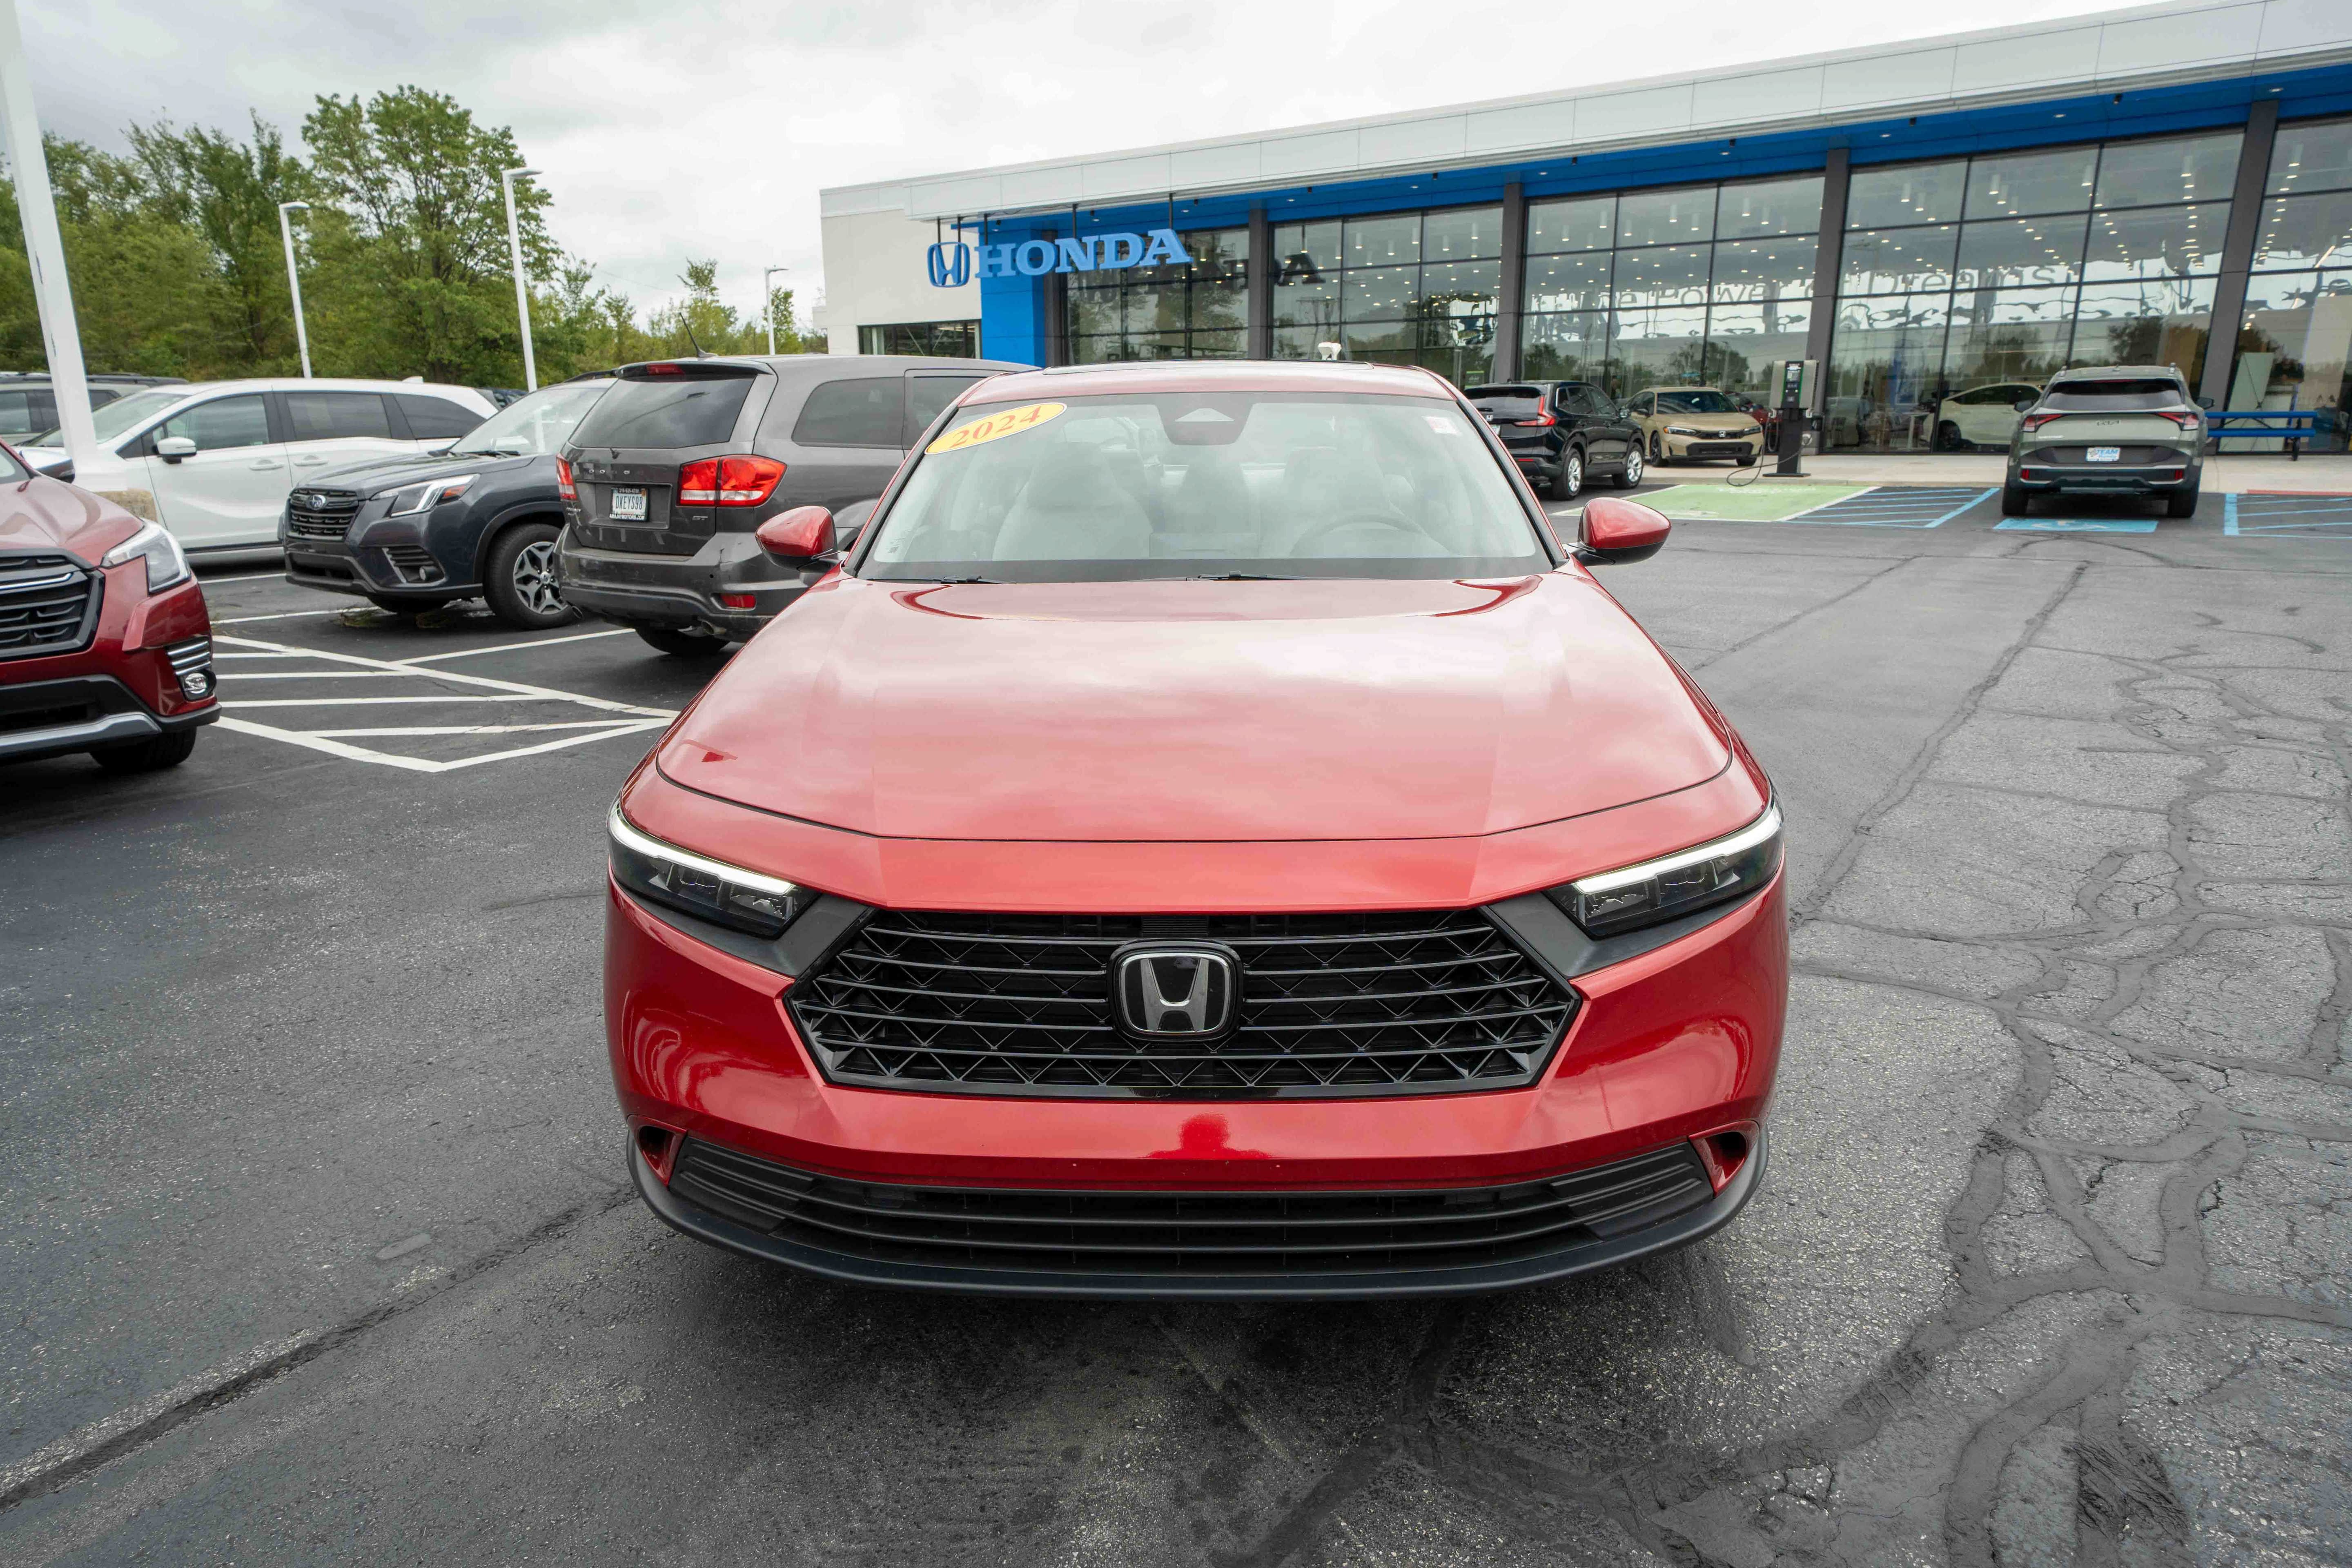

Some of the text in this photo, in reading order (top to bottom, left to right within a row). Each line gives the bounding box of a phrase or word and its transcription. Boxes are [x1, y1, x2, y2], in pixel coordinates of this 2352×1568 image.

[975, 229, 1193, 278] HONDA
[949, 406, 1041, 449] 2024
[615, 495, 643, 510] DKEYS98
